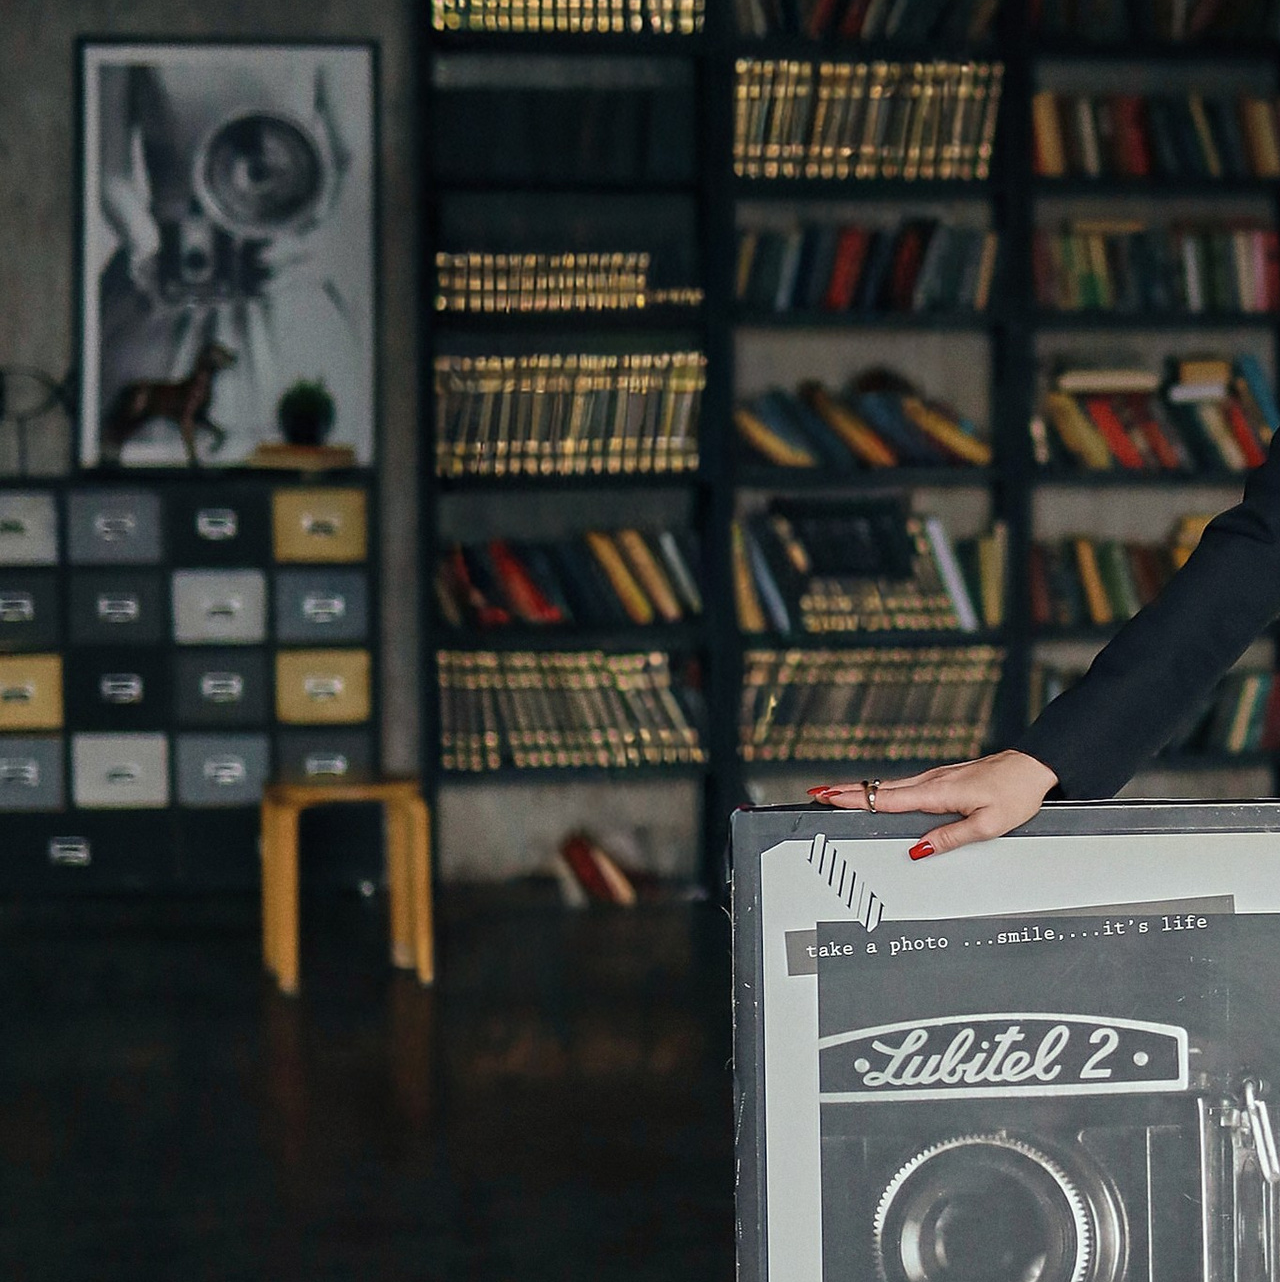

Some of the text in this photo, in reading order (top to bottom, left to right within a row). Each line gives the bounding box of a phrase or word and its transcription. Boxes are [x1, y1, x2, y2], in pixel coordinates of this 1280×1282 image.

[806, 941, 854, 958] take
[866, 942, 878, 954] a
[890, 936, 949, 956] photo
[1162, 914, 1208, 933] life
[863, 1025, 1120, 1087] Lubitel 2
